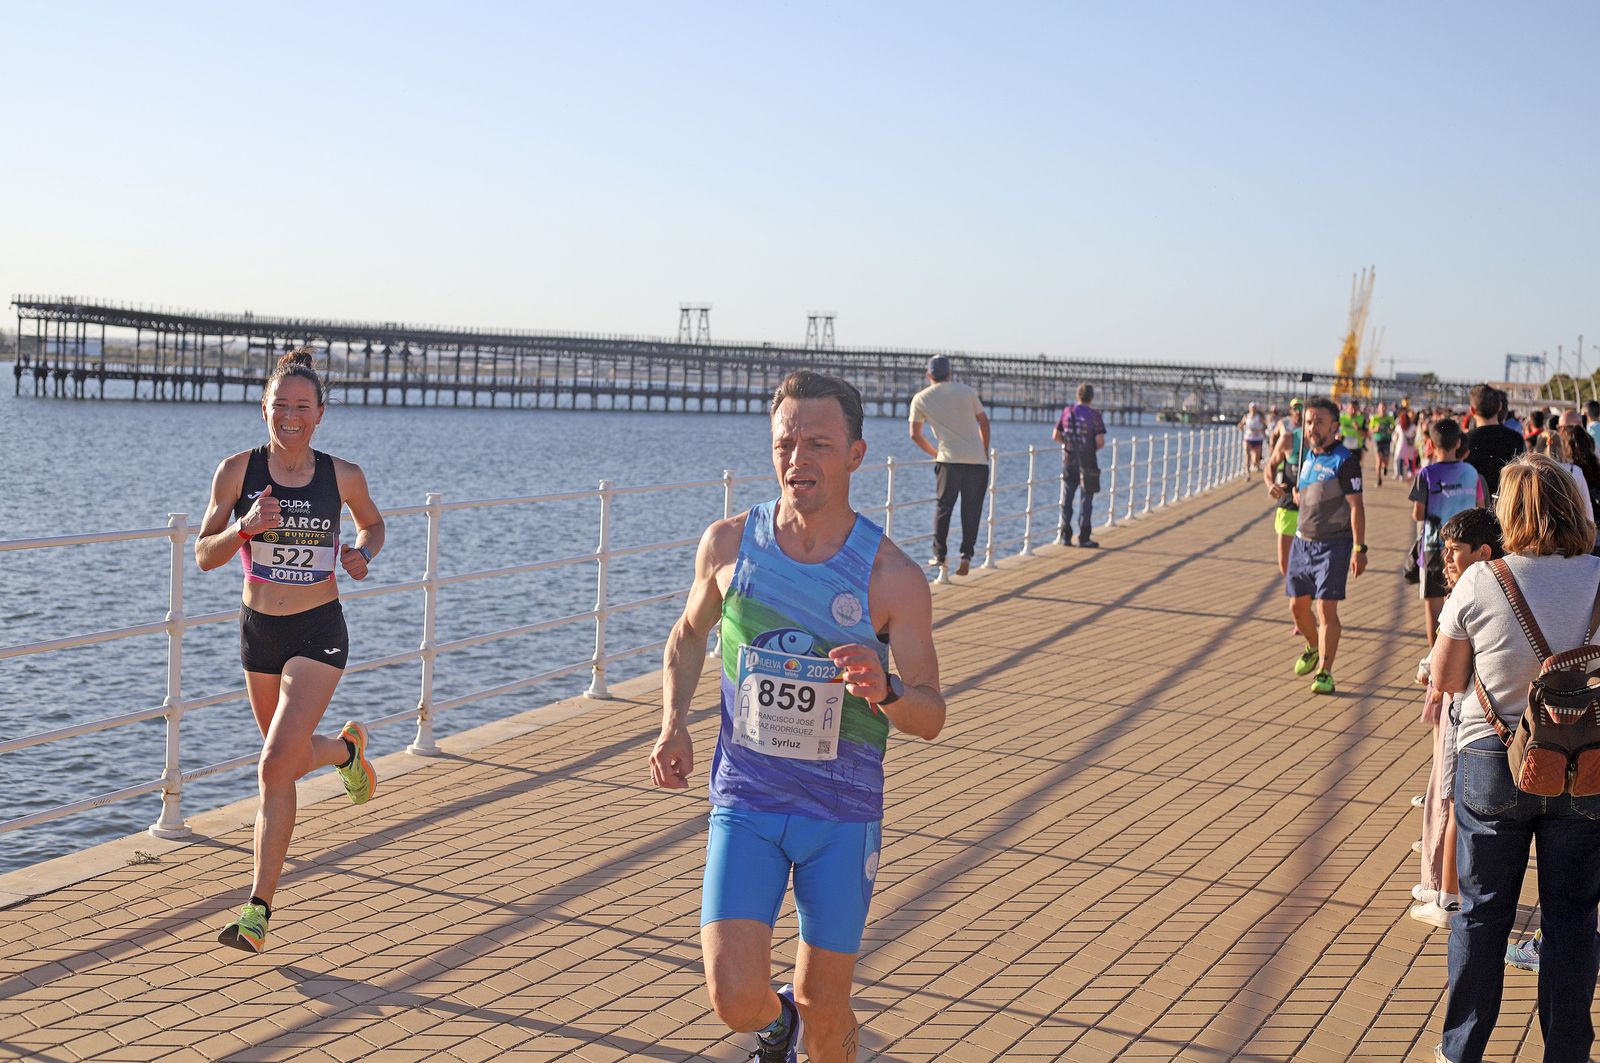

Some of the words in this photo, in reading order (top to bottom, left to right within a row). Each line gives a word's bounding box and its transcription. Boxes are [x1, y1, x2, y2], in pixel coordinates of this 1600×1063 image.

[280, 499, 312, 509] CUPA
[272, 547, 314, 568] 522
[759, 658, 781, 669] HUELVA
[806, 665, 837, 679] 2023
[758, 679, 816, 713] 859
[771, 737, 801, 750] Syrluz
